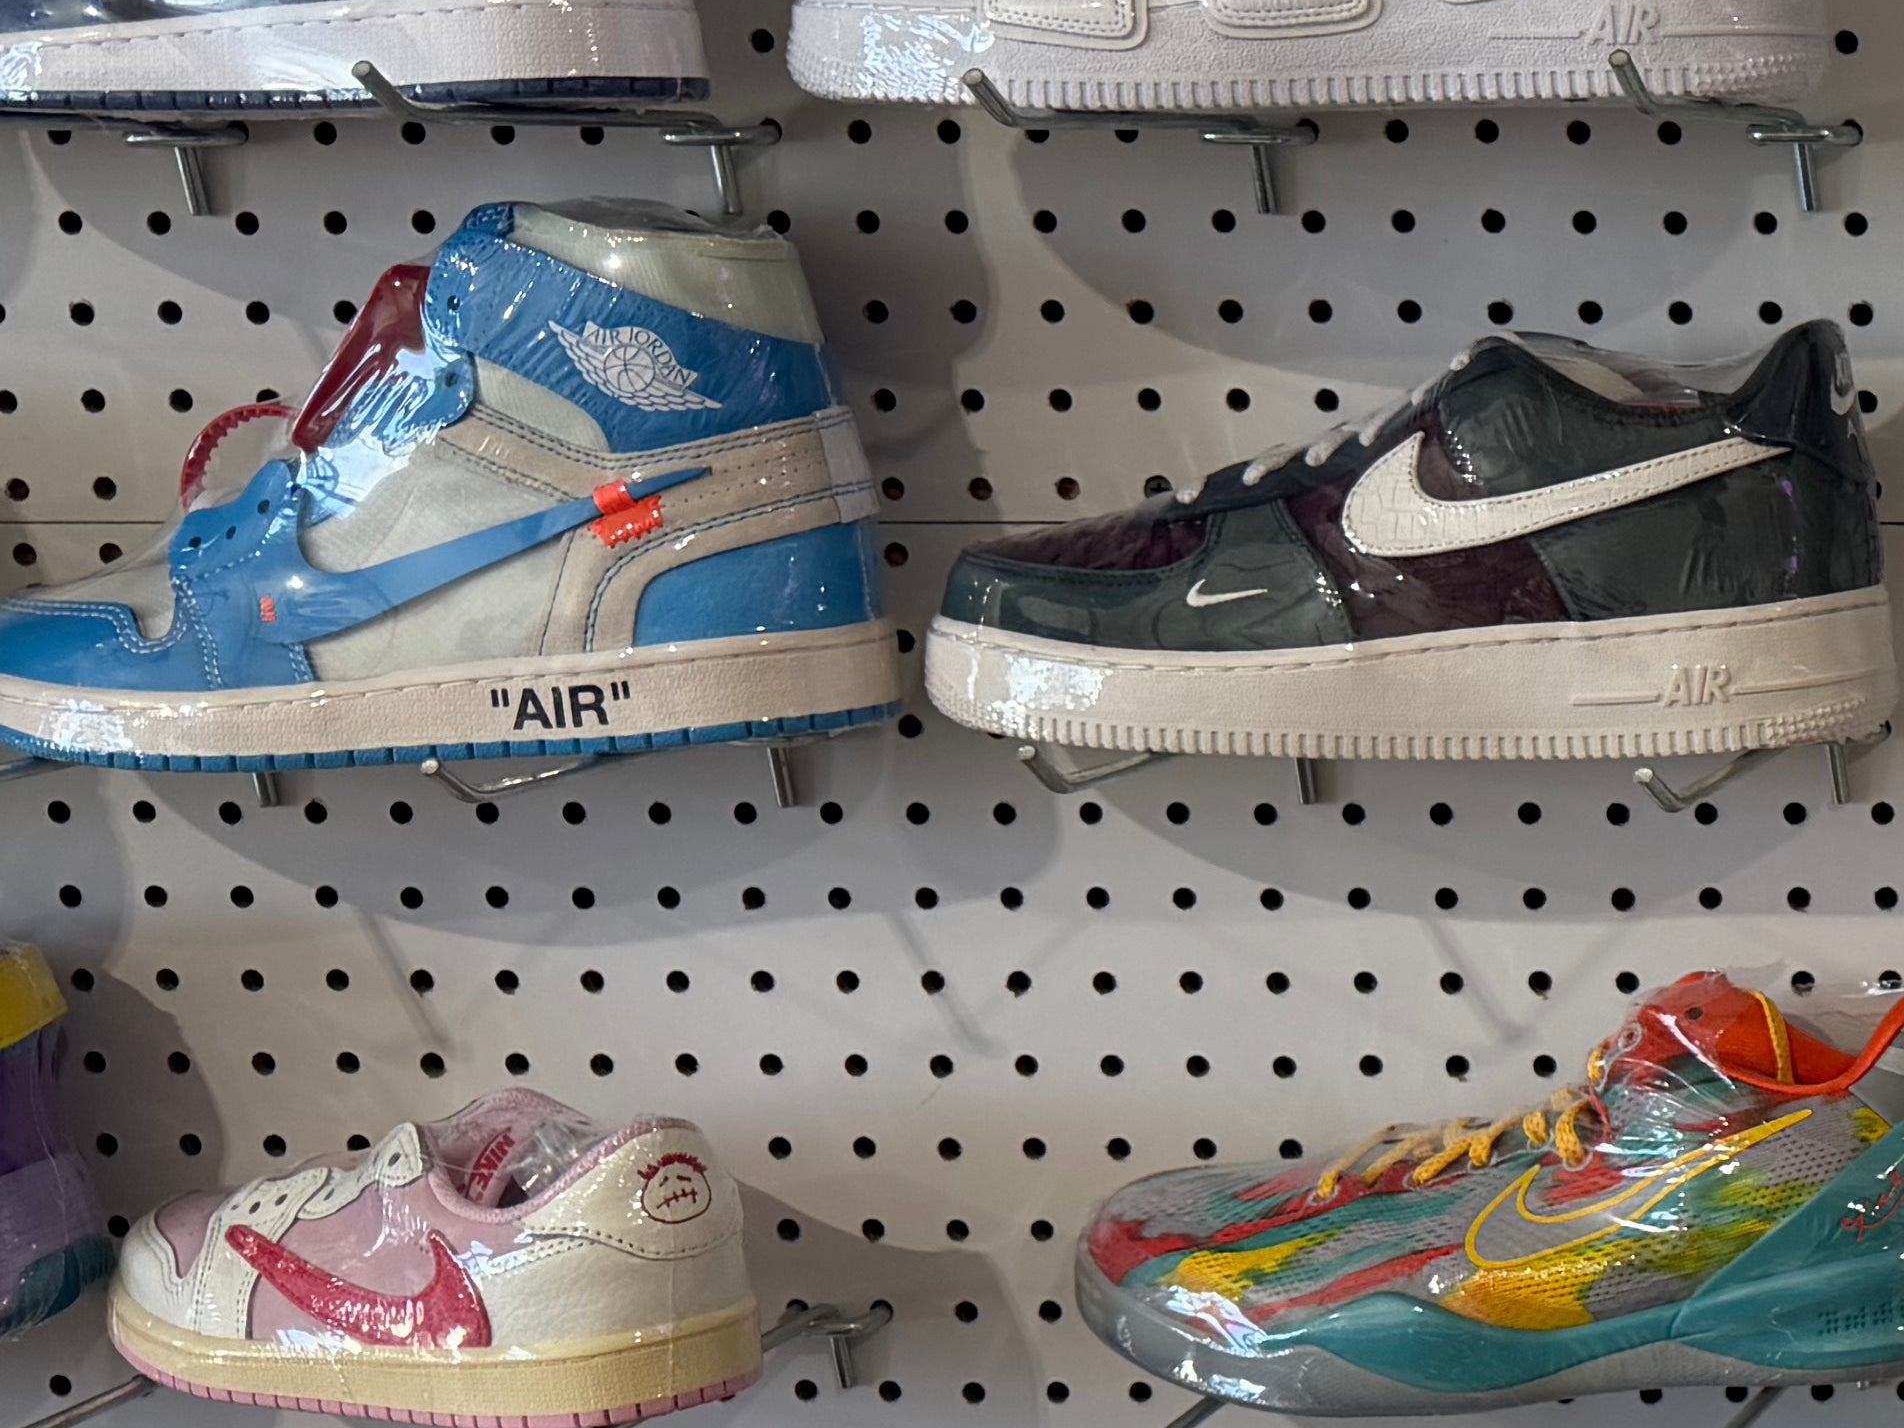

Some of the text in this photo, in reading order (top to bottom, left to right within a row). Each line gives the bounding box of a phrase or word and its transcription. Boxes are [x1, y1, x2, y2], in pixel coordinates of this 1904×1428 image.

[1588, 2, 1662, 47] AIR
[585, 326, 691, 385] AIR JORDAN
[490, 680, 631, 731] "AIR"
[1663, 663, 1733, 708] AIR
